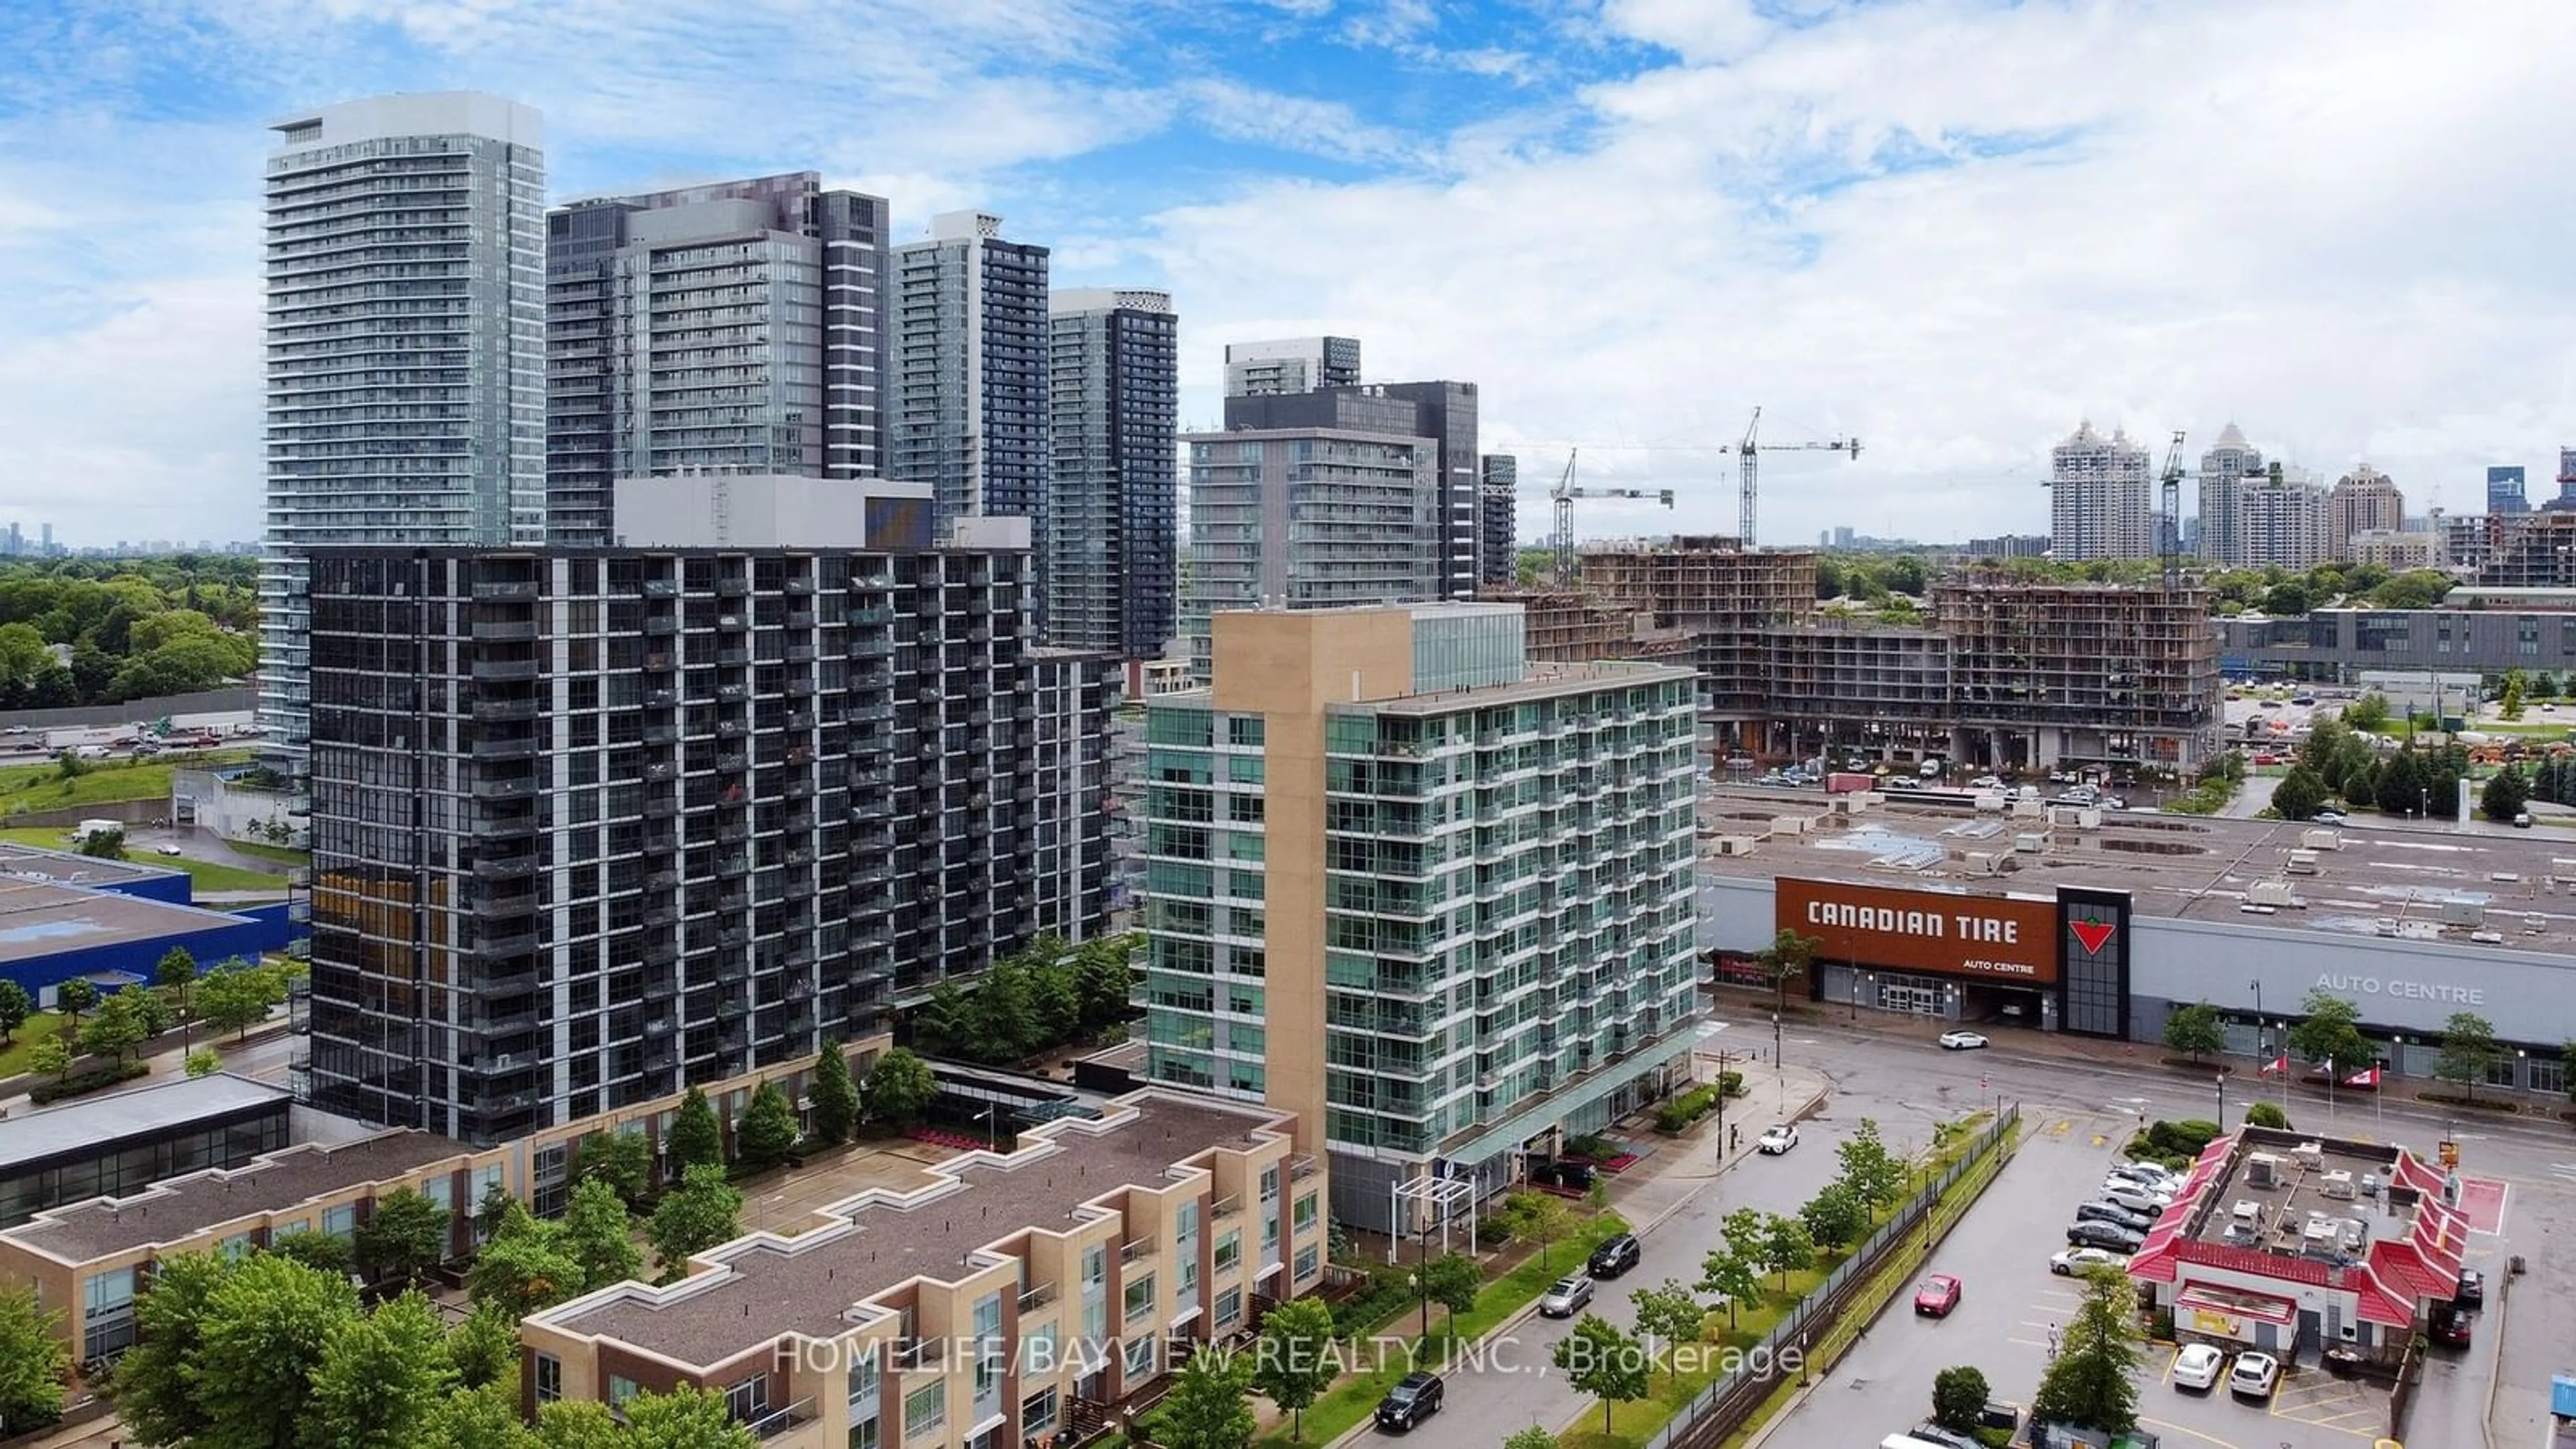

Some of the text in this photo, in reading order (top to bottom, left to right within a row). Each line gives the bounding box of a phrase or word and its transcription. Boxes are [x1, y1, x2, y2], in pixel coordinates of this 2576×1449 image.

[1809, 902, 2017, 943] CANADIAN TIRE
[1964, 959, 2034, 975] AUTO CENTRE
[2317, 973, 2484, 1006] AUTO CENTRE
